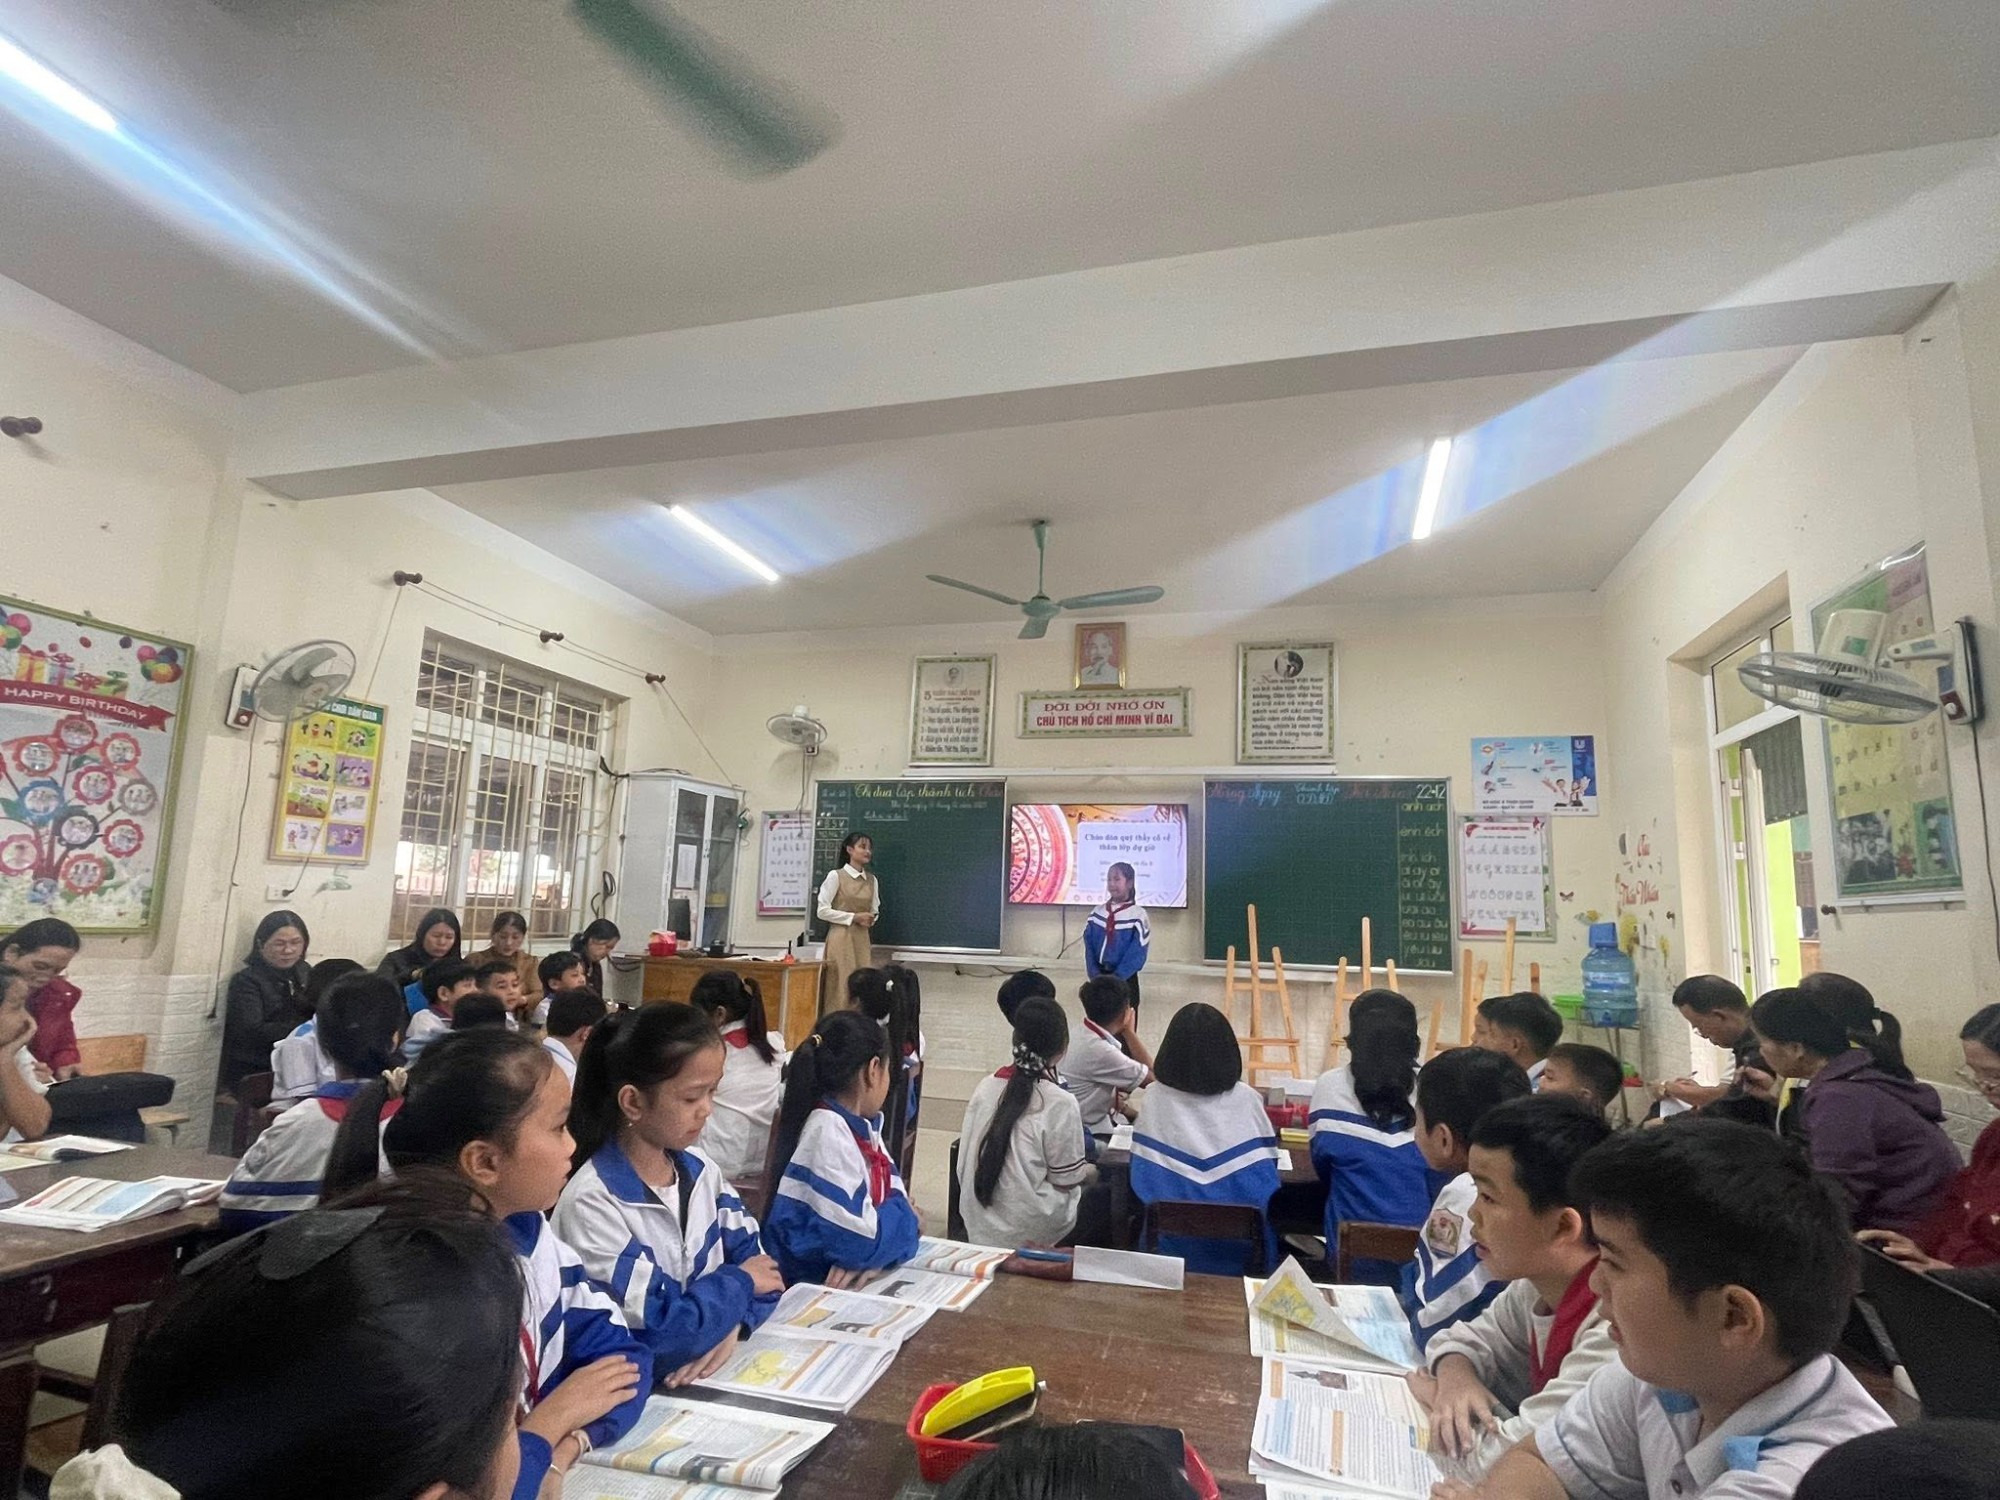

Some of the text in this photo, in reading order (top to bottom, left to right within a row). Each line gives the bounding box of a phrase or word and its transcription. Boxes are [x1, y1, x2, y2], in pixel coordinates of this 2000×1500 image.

[4, 687, 148, 720] HAPPY BIRTHDAY
[1106, 700, 1139, 711] NHỚ
[1143, 700, 1165, 710] ƠN
[1036, 711, 1055, 727] CHỦ
[1058, 715, 1079, 728] TỊCH
[1081, 712, 1095, 726] HỒ
[1096, 713, 1113, 726] CHÍ
[1115, 714, 1142, 726] MINH
[1156, 713, 1173, 727] ĐẠI
[918, 783, 952, 797] thành
